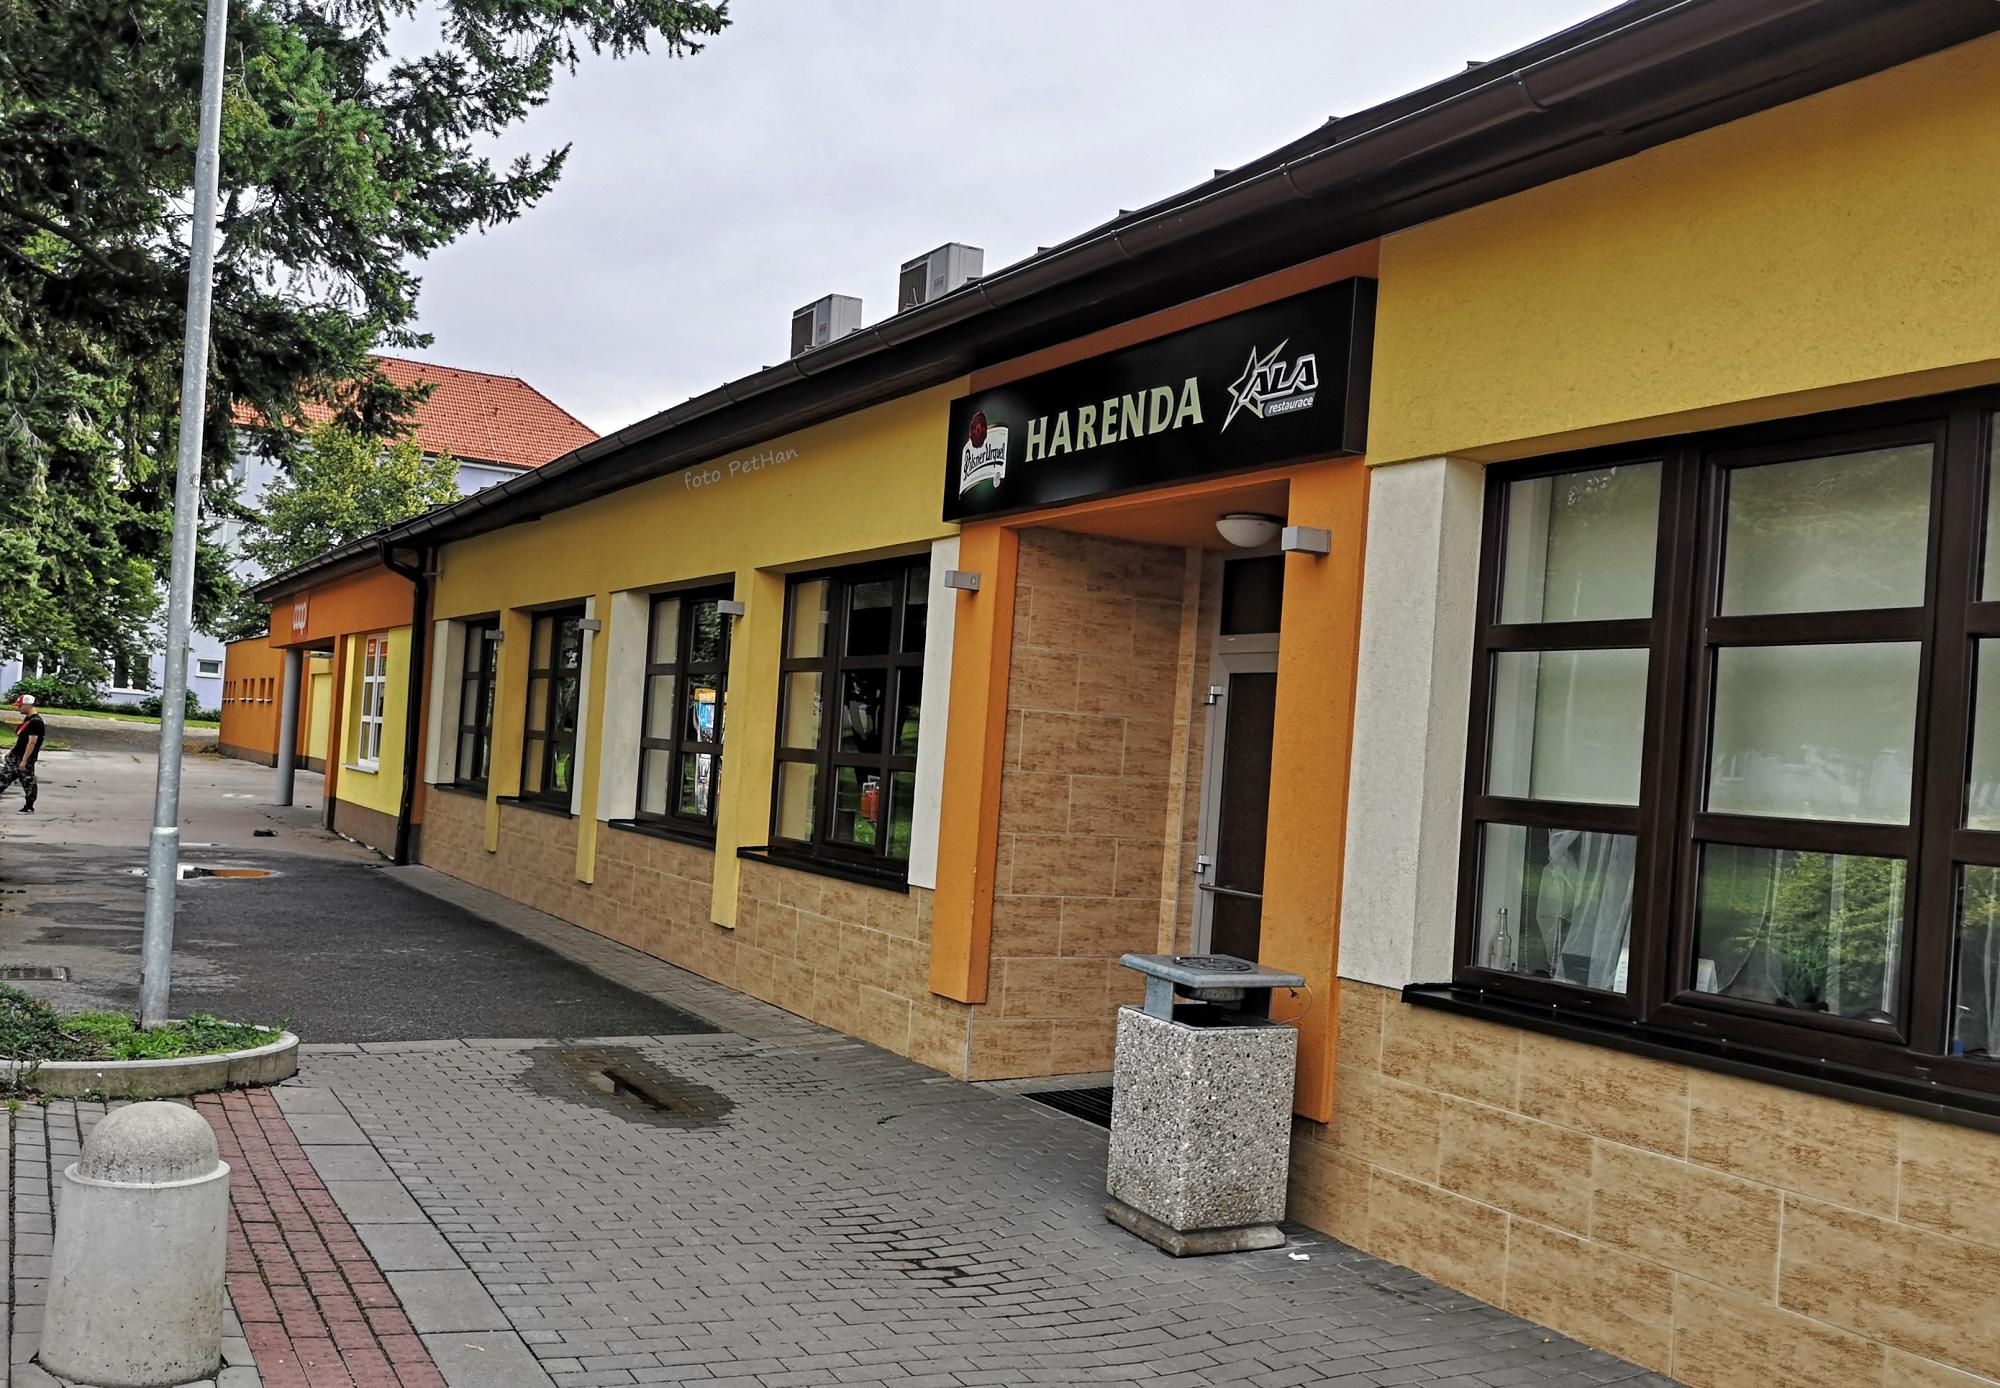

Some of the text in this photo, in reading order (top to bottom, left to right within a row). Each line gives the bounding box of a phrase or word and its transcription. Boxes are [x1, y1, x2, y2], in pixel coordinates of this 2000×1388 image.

[1239, 354, 1318, 402] ALA
[1025, 377, 1204, 462] HARENDA
[1268, 396, 1314, 413] restaurace
[963, 449, 985, 481] Pilsner
